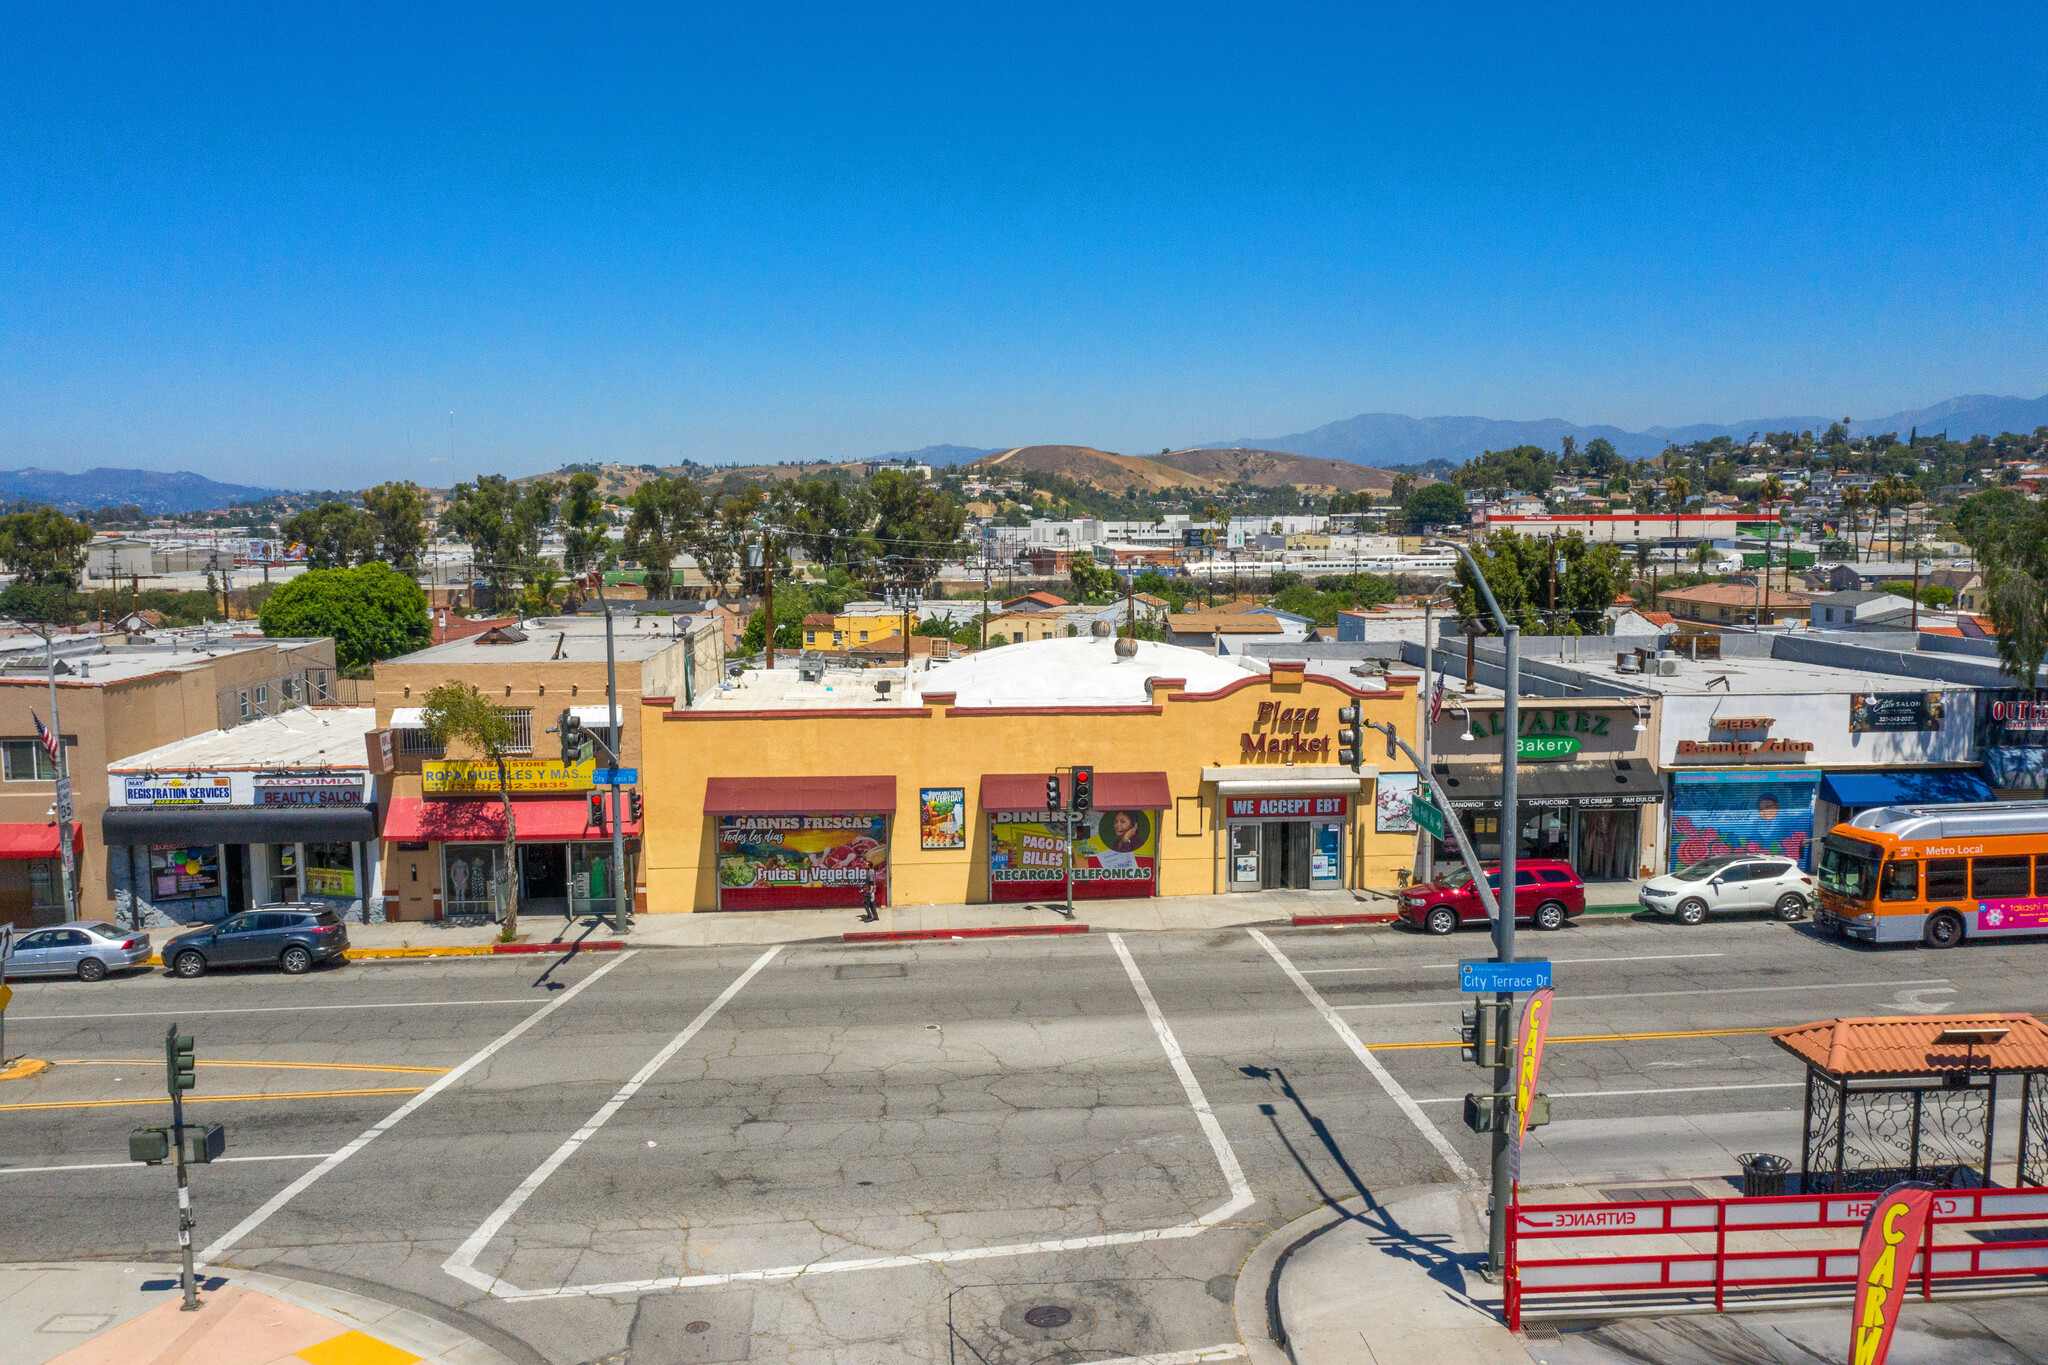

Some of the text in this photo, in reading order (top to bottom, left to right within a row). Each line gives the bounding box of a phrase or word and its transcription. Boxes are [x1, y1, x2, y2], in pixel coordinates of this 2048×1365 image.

[1257, 701, 1320, 722] Plaza
[1242, 731, 1331, 752] Market
[1517, 739, 1573, 753] Bakery
[1678, 738, 1814, 756] Beauty Salon
[537, 769, 546, 780] Y
[128, 787, 230, 799] REGISTRATION SERVICES
[264, 791, 361, 804] BEAUTY SALON
[933, 795, 962, 803] EVERYDAY
[61, 802, 71, 819] 35
[1233, 798, 1341, 815] WE ACCEPT EBT
[735, 816, 873, 830] CARNES FRESCAS
[997, 811, 1084, 823] DINERO
[723, 829, 785, 844] Todos los dias
[1022, 835, 1054, 850] PAGO
[1926, 844, 1983, 856] Metro Local
[1022, 851, 1063, 866] BILLES
[757, 867, 867, 883] Frutas y Vegetale
[994, 868, 1064, 881] RECARGAS
[2010, 902, 2041, 911] takashi
[1464, 974, 1549, 990] City Terrace Dr
